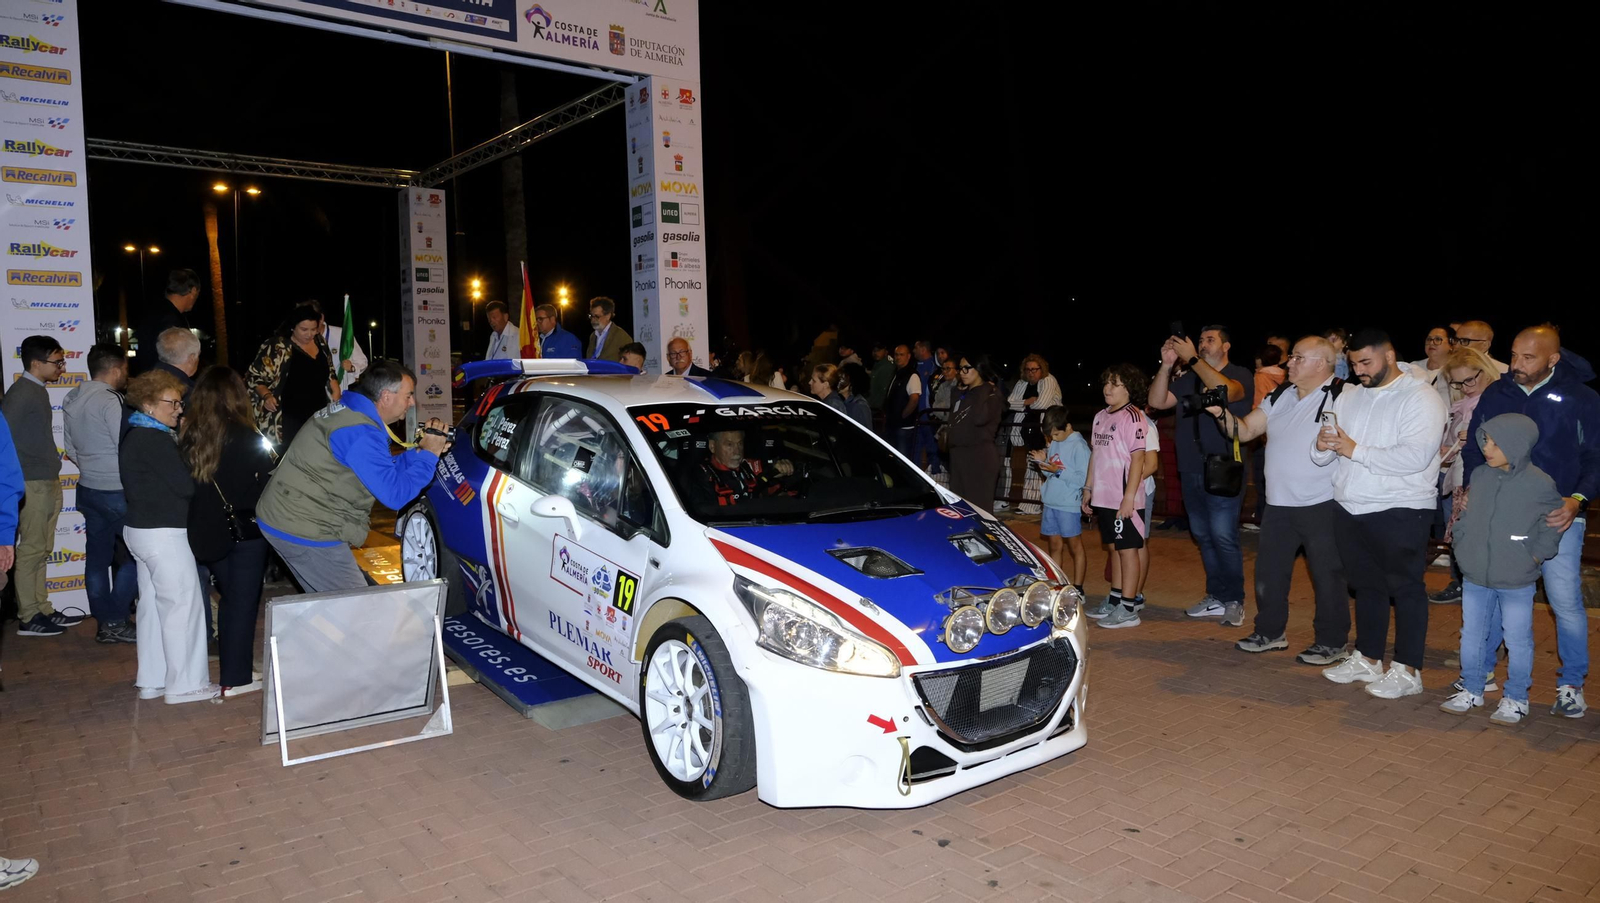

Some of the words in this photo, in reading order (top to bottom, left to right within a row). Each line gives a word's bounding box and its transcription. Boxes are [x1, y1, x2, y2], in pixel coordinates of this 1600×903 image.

[554, 20, 585, 35] COSTA
[586, 27, 598, 38] DE
[0, 34, 68, 56] Rallycar
[546, 30, 600, 51] ALMERÍA
[630, 37, 685, 57] DIPUTACIÓN
[630, 48, 642, 58] DE
[644, 51, 684, 66] ALMERÍA
[11, 66, 57, 80] Recalvi
[19, 96, 70, 106] MICHELIN
[4, 138, 73, 158] Rallycar
[16, 170, 62, 184] Recalvi
[660, 181, 698, 195] MOYA
[24, 198, 74, 207] MICHELIN
[662, 208, 678, 217] UNED
[633, 230, 654, 248] gasolia
[662, 232, 700, 243] gasolia
[10, 242, 78, 258] Rallycar
[22, 272, 68, 284] Recalvi
[664, 277, 702, 290] Phonika
[416, 286, 445, 295] gasolia
[418, 316, 446, 326] Phonika
[714, 406, 817, 417] GARCÍA
[498, 417, 516, 434] Pérez
[636, 413, 670, 433] 19
[491, 432, 510, 450] Pérez
[1114, 519, 1124, 533] 9
[570, 560, 583, 572] COSTA
[566, 566, 588, 586] ALMERÍA
[618, 575, 635, 611] 19
[548, 610, 614, 667] PLEMAR
[444, 616, 538, 683] resores.es
[586, 655, 623, 685] SPORT
